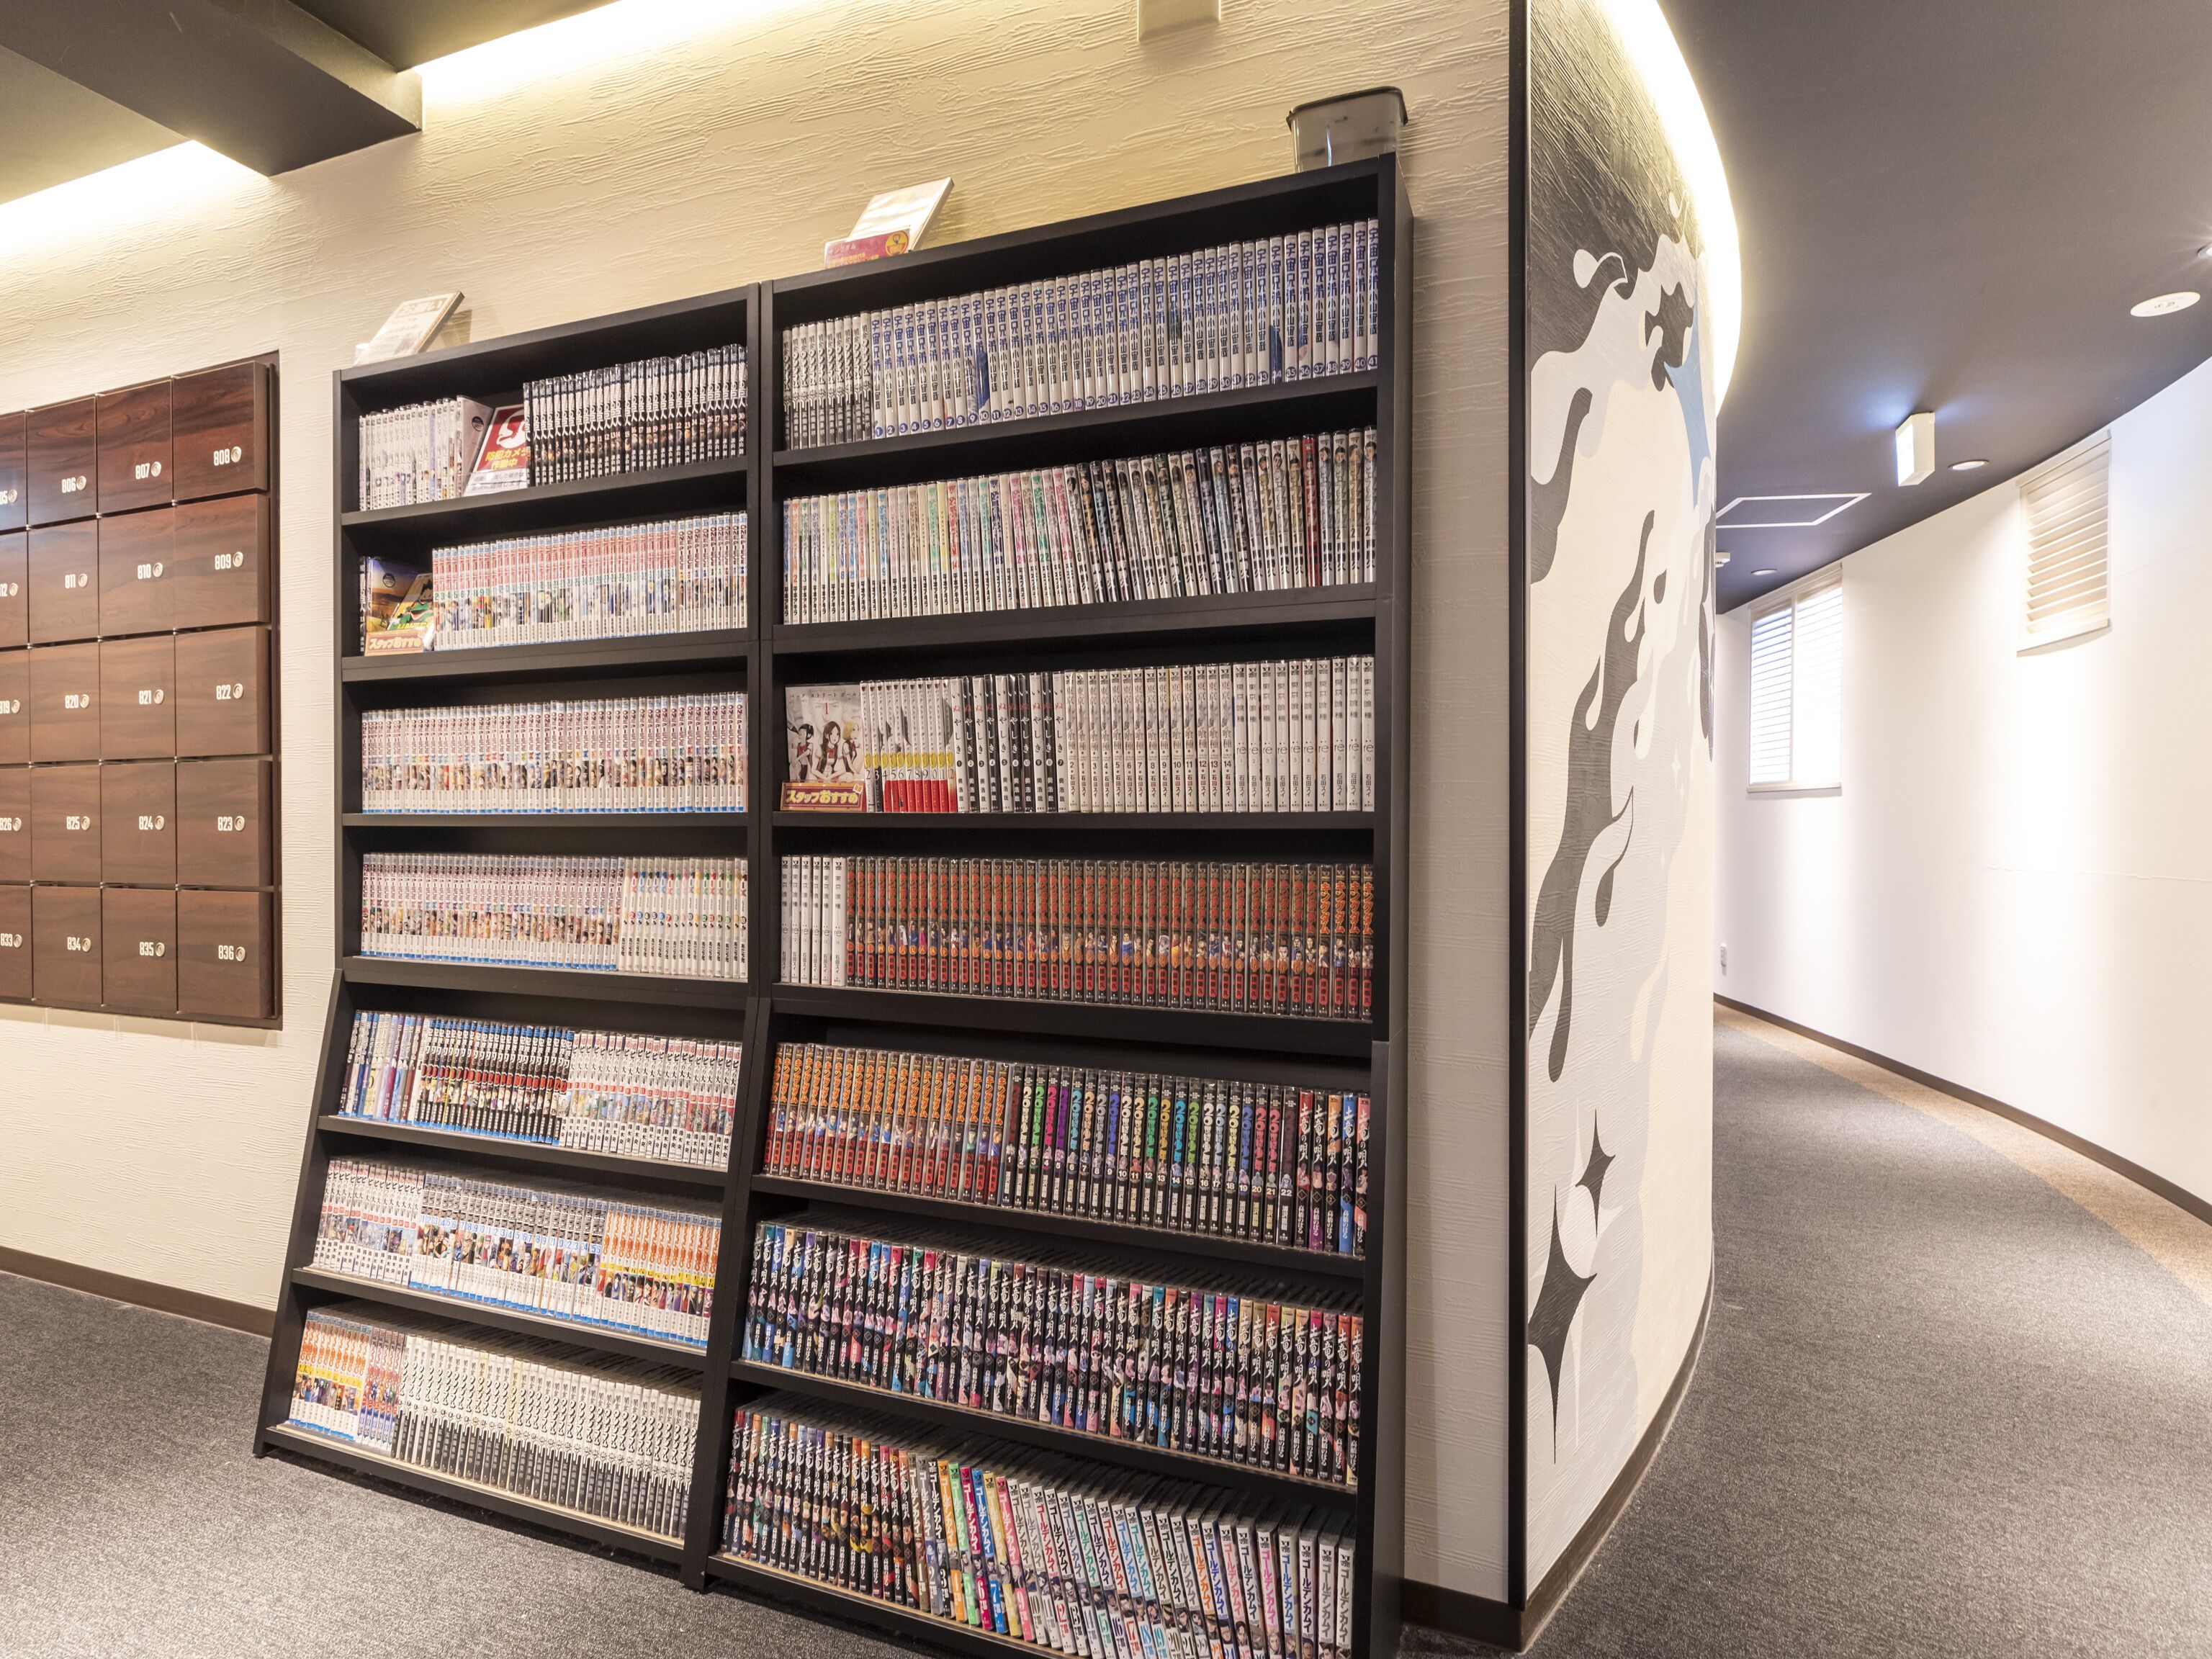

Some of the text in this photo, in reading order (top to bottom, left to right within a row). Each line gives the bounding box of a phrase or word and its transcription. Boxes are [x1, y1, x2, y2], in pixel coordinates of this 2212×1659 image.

[1193, 258, 1204, 317] 宇宙兄弟
[1285, 243, 1296, 304] 宇宙兄弟
[1314, 237, 1325, 299] 宇宙兄弟
[1341, 233, 1352, 295] 宇宙兄弟
[986, 298, 997, 353] 宇宙兄弟
[1009, 294, 1020, 349] 宇宙兄弟
[1033, 289, 1044, 344] 宇宙兄弟
[1056, 285, 1067, 341] 宇宙兄弟
[1104, 276, 1115, 333] 宇宙兄弟
[894, 315, 904, 368] 宇宙兄弟
[915, 310, 927, 364] 宇宙兄弟
[939, 307, 950, 360] 宇宙兄弟
[135, 463, 150, 480] 807
[213, 449, 230, 466] 808
[61, 477, 76, 493] 806
[65, 575, 76, 588] 811
[138, 564, 151, 580] 810
[215, 554, 231, 570] 809
[65, 694, 79, 709] 820
[139, 691, 151, 705] 821
[216, 685, 231, 700] 822
[786, 790, 858, 804] スタッフおすすめ
[866, 770, 871, 780] 2
[891, 769, 896, 779] 5
[898, 769, 904, 778] 6
[907, 770, 912, 780] 7
[914, 770, 920, 779] 8
[0, 817, 12, 831] 826
[66, 816, 80, 830] 825
[139, 816, 153, 830] 824
[217, 817, 233, 831] 823
[1321, 881, 1331, 935] キングダム
[1349, 881, 1360, 935] キングダム
[1363, 881, 1374, 935] キングダム
[0, 933, 12, 946] 833
[67, 937, 81, 950] 834
[140, 941, 154, 956] 835
[218, 945, 234, 961] 836
[790, 1058, 803, 1105] キングダム
[852, 1064, 865, 1111] キングダム
[886, 1066, 898, 1114] キングダム
[920, 1070, 932, 1118] キングダム
[956, 1074, 968, 1123] キングダム
[994, 1076, 1007, 1125] キングダム
[1313, 1104, 1327, 1164] 土竜の唄
[1342, 1105, 1357, 1166] 土竜の唄
[1357, 1110, 1370, 1169] 土竜の唄
[1162, 1300, 1176, 1360] 土竜の唄
[1188, 1304, 1202, 1364] 土竜の唄
[1213, 1308, 1226, 1370] 土竜の唄
[1238, 1312, 1251, 1372] 土竜の唄
[871, 1454, 881, 1514] 土竜の唄
